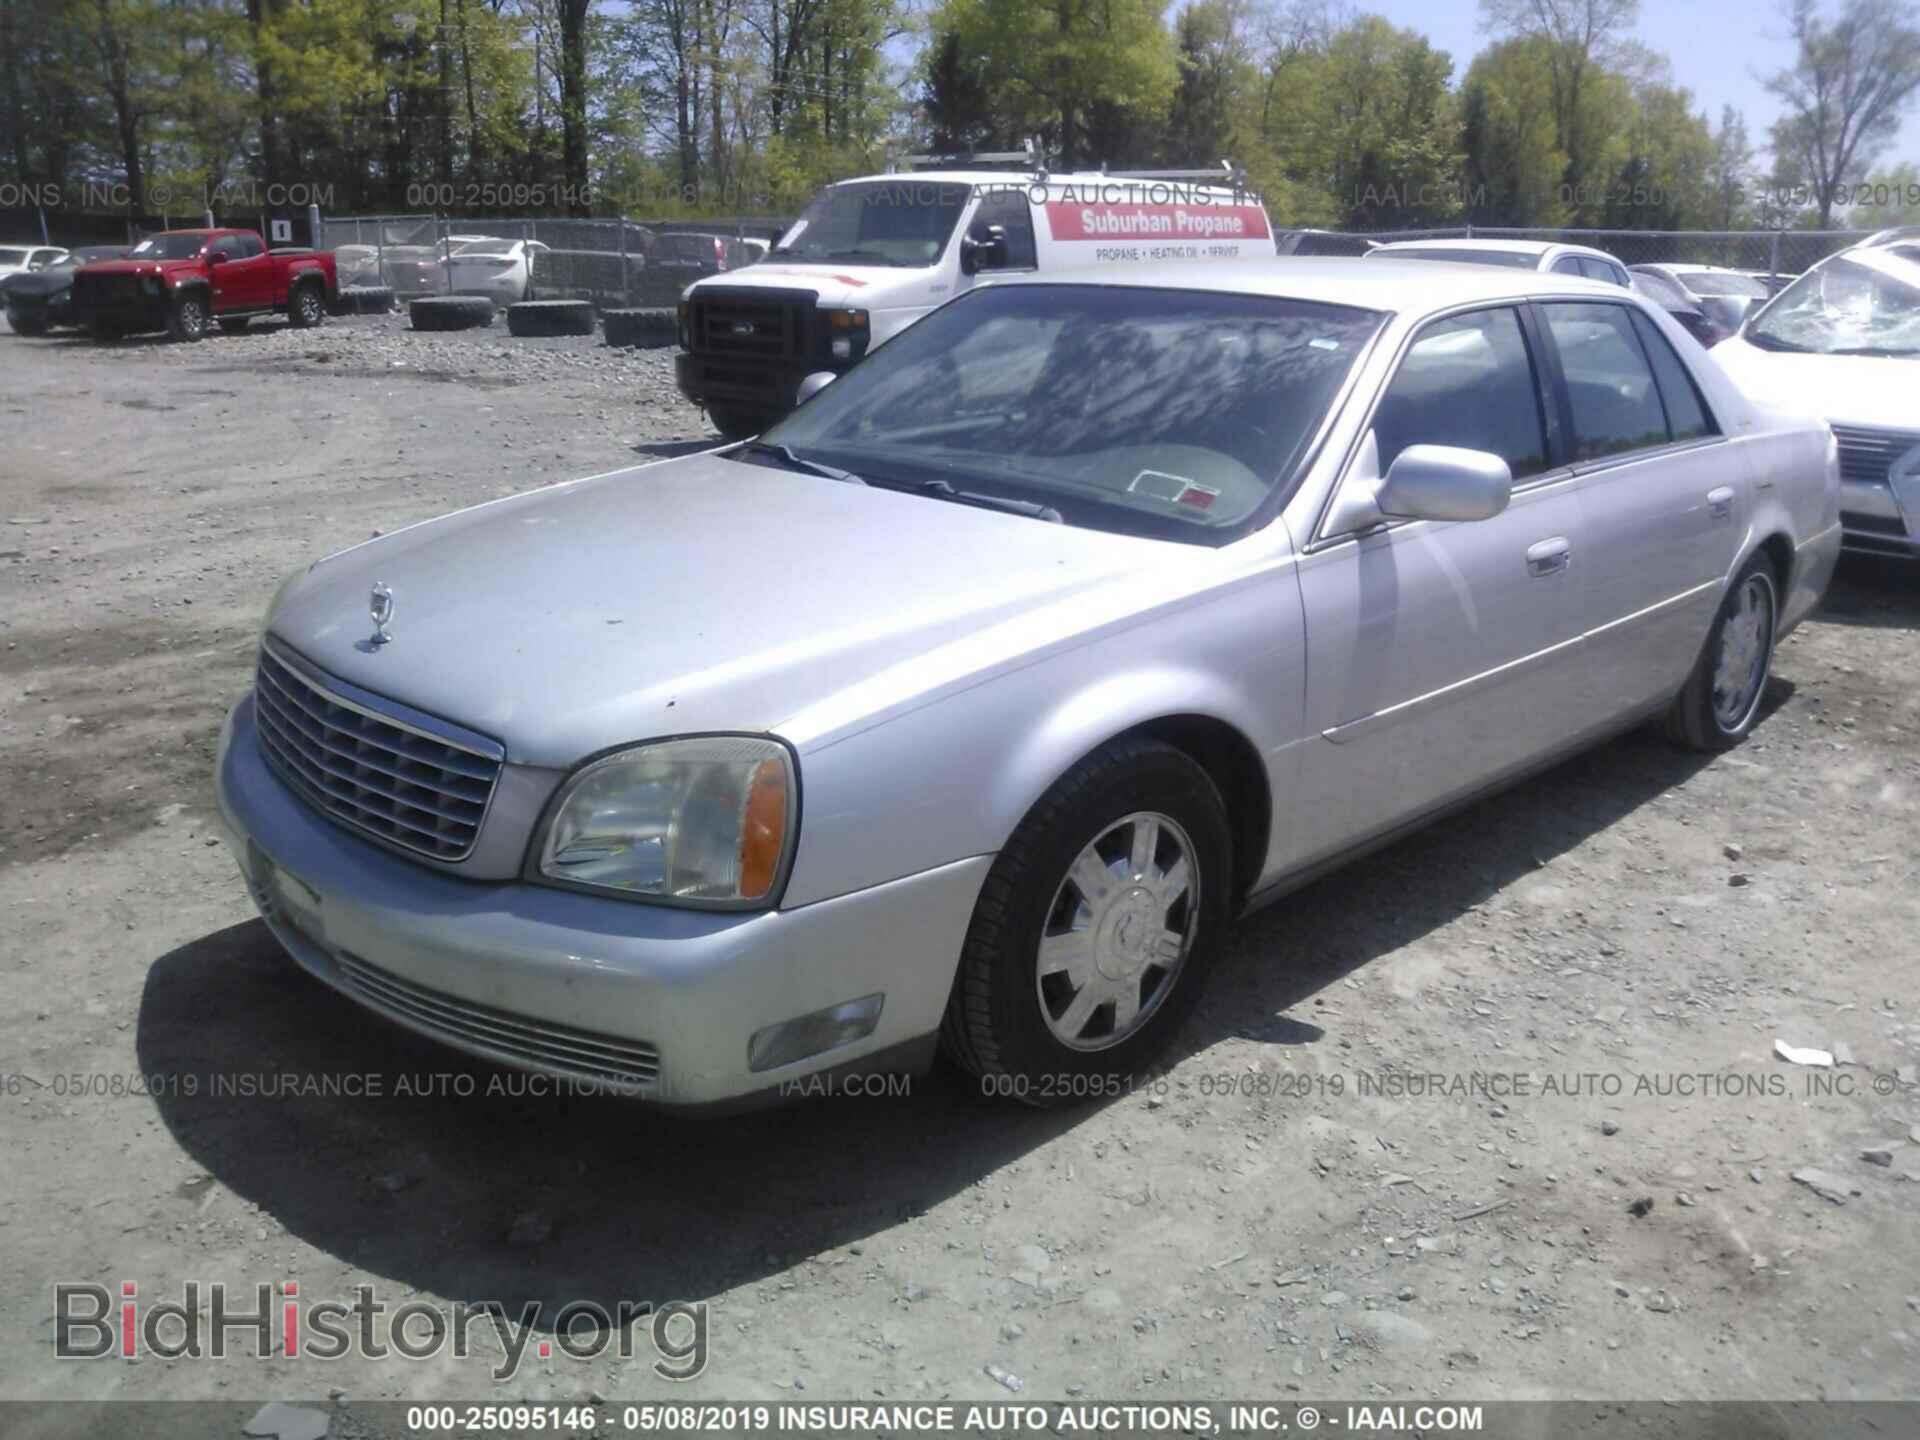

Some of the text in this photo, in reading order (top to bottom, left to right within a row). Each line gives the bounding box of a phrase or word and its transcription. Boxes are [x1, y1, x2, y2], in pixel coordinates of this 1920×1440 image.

[1081, 209, 1243, 236] Suburban Propane
[1096, 248, 1139, 260] PROPANE
